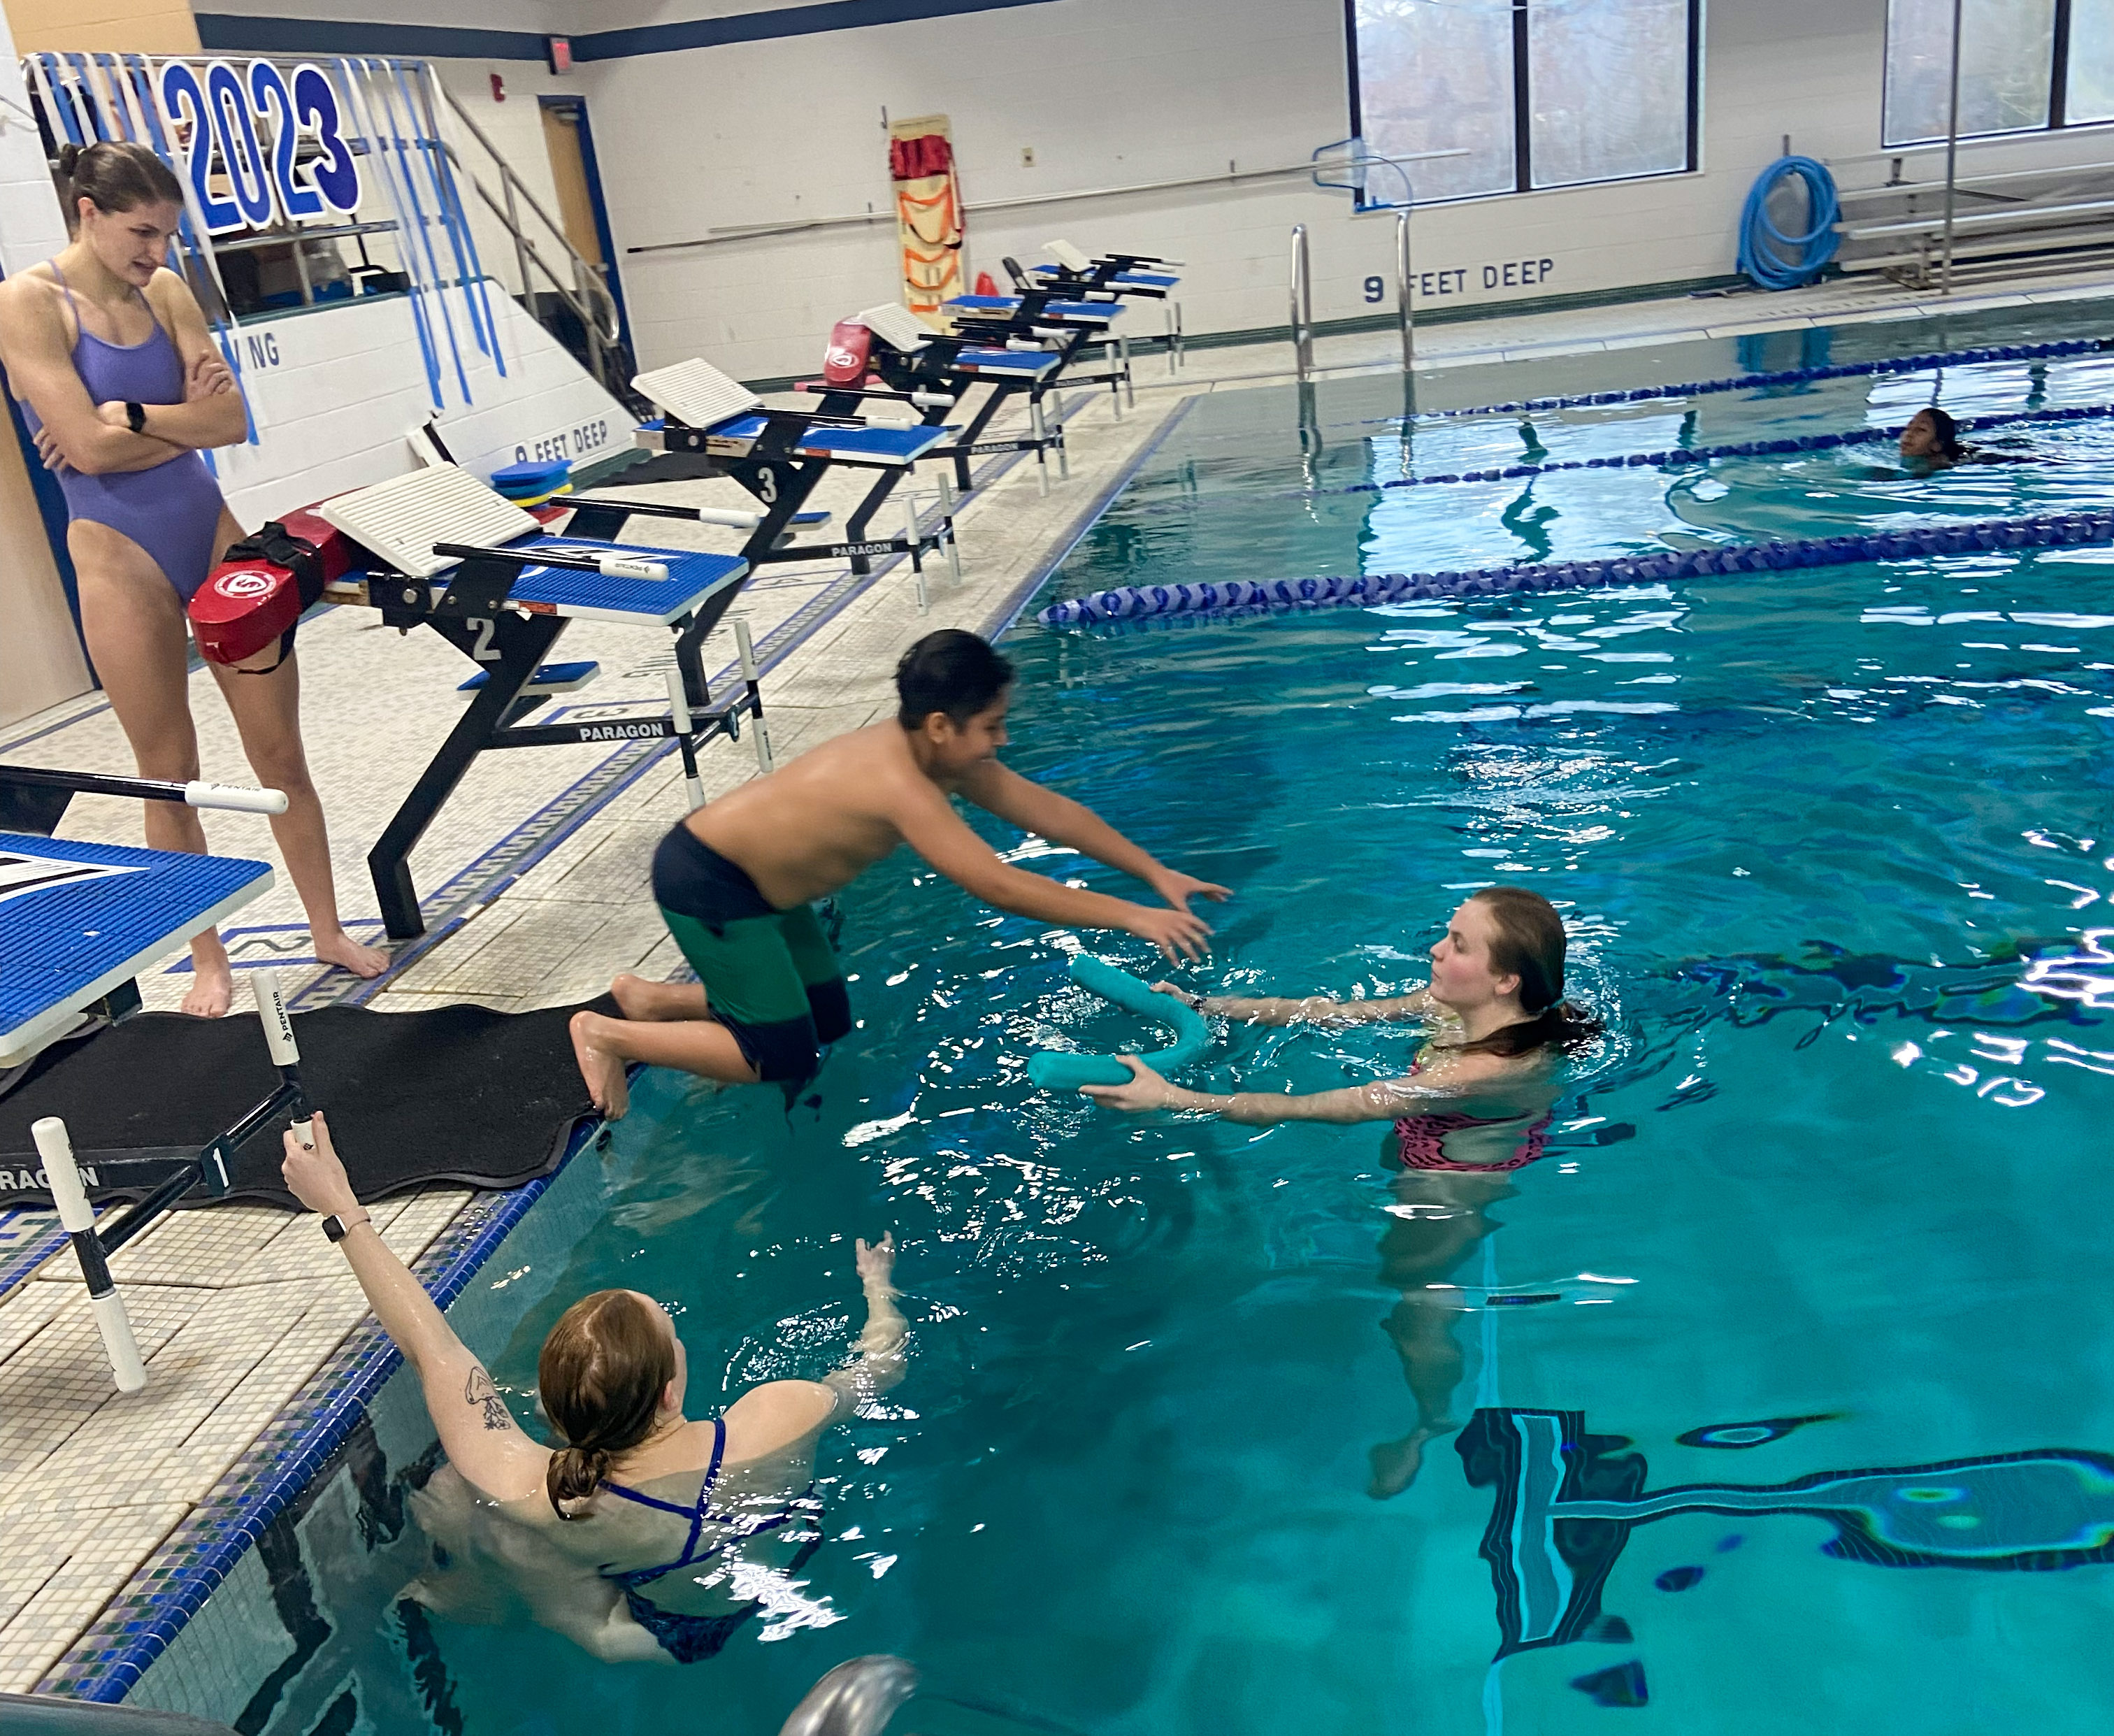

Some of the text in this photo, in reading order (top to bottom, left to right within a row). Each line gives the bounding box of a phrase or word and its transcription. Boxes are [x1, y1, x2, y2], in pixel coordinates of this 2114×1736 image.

[160, 57, 362, 236] 2023
[1364, 275, 1384, 303] 9
[1483, 258, 1553, 289] DEEP
[535, 433, 569, 462] FEET
[573, 420, 607, 453] DEEP
[758, 467, 777, 503] 3
[831, 543, 892, 557] PARAGON
[467, 617, 502, 661] 2
[579, 724, 664, 741] PARAGON
[273, 991, 289, 1031] PENTAIR
[213, 1147, 229, 1188] 1
